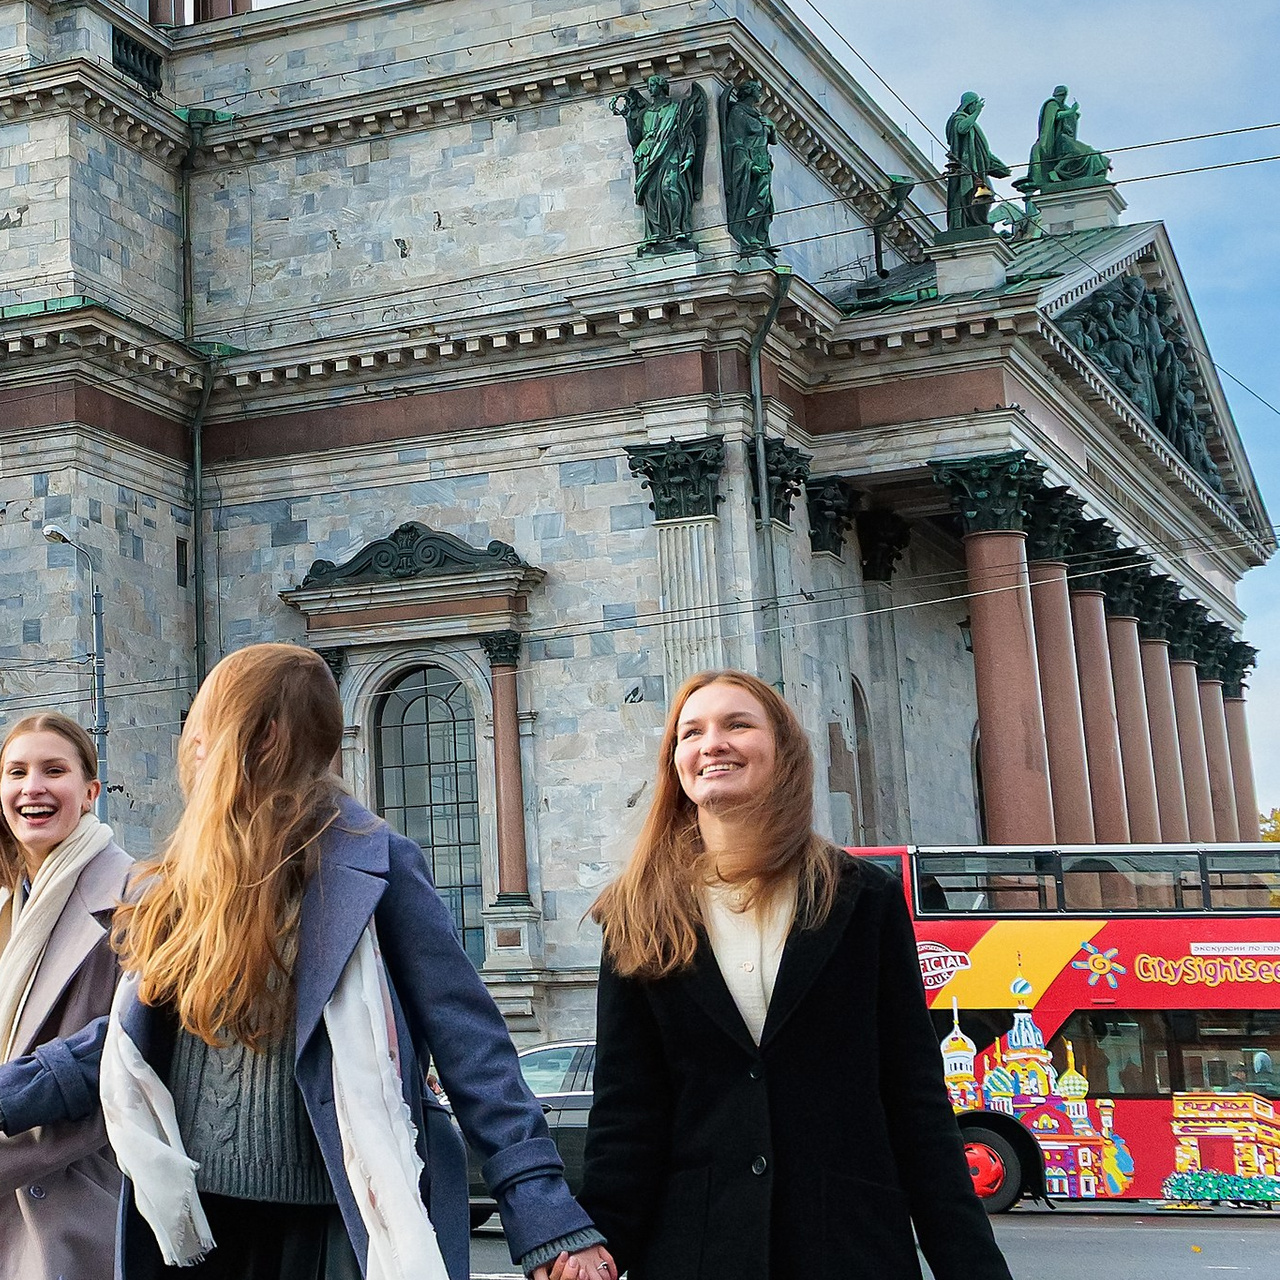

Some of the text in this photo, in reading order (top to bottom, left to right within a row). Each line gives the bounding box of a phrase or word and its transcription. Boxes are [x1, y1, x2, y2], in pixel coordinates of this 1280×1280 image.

[1193, 945, 1246, 953] экскурсии
[919, 955, 969, 972] FICIAL
[923, 971, 952, 986] OUR
